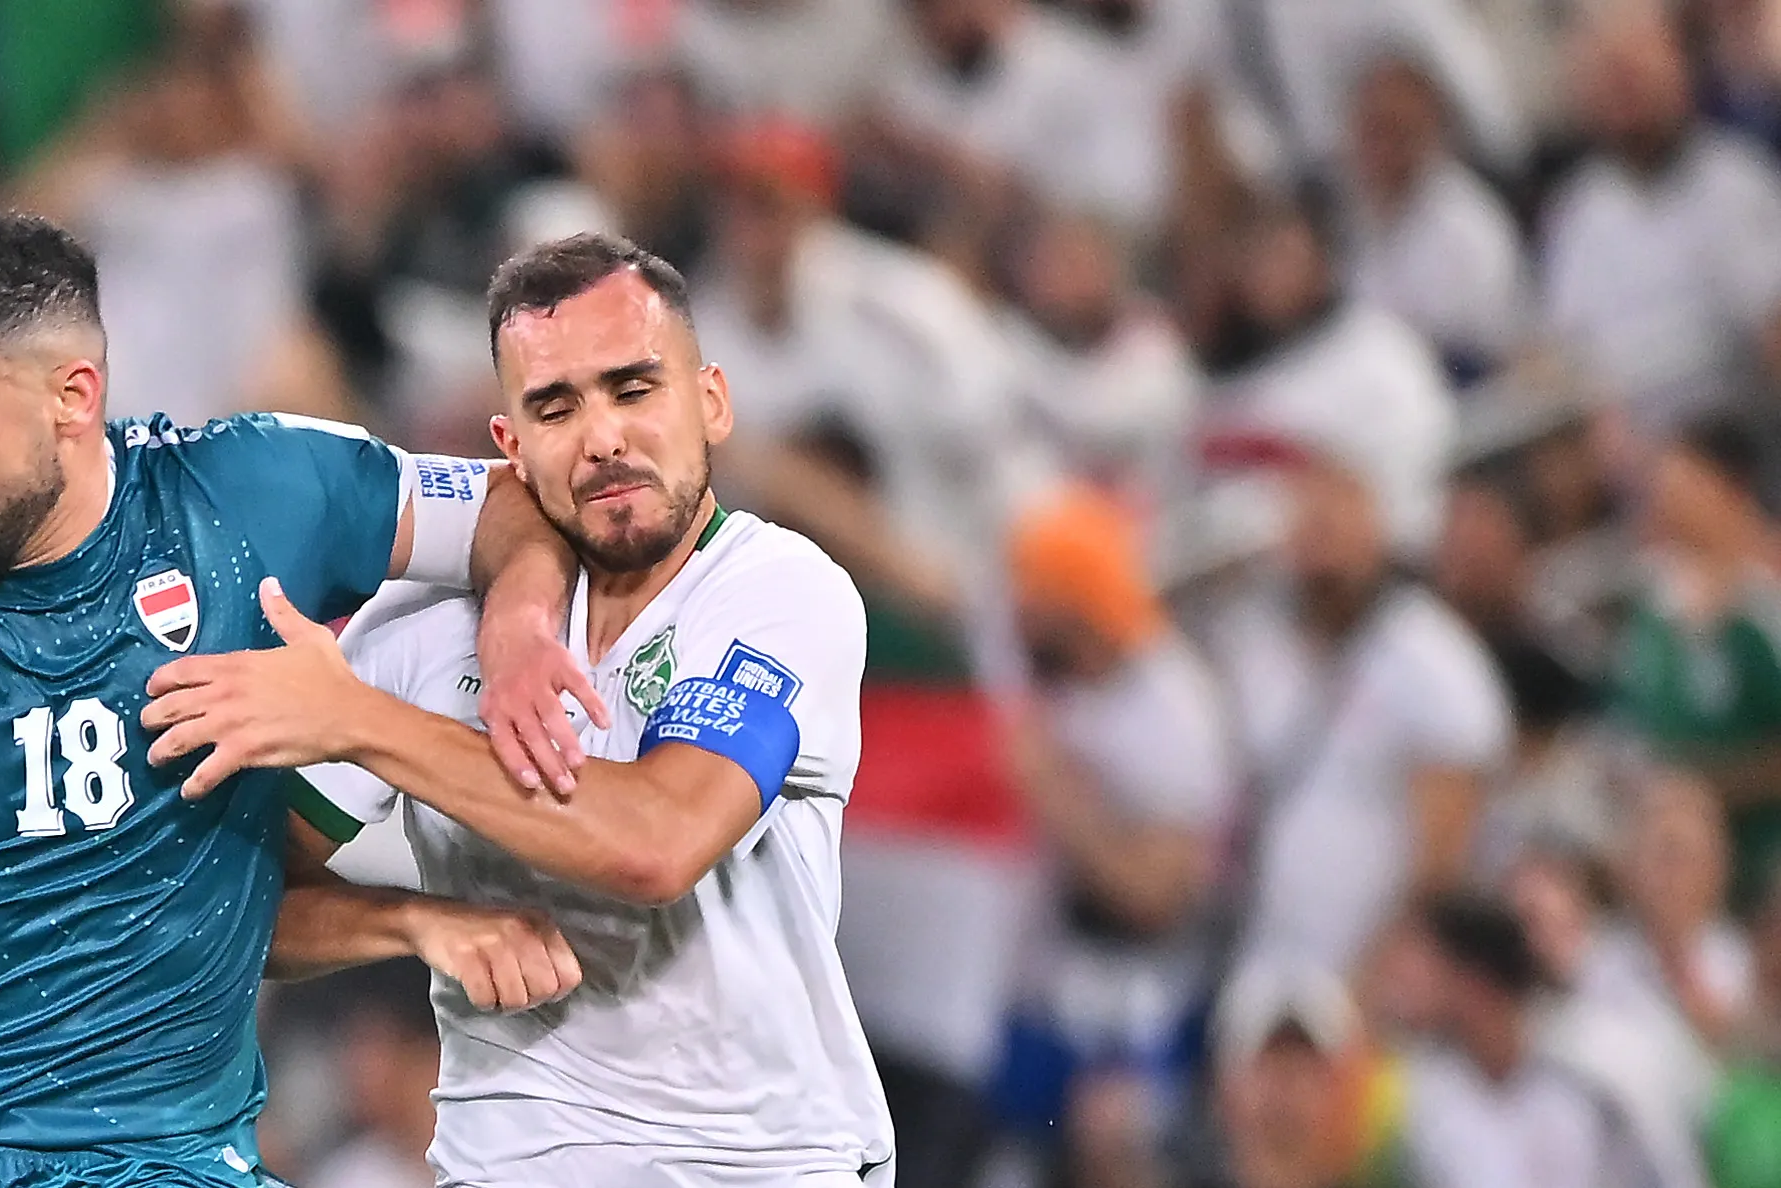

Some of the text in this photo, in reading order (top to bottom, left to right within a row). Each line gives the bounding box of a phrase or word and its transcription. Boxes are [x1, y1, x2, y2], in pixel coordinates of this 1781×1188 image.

[732, 667, 782, 698] UNITES
[671, 707, 746, 737] World
[13, 697, 135, 837] 18
